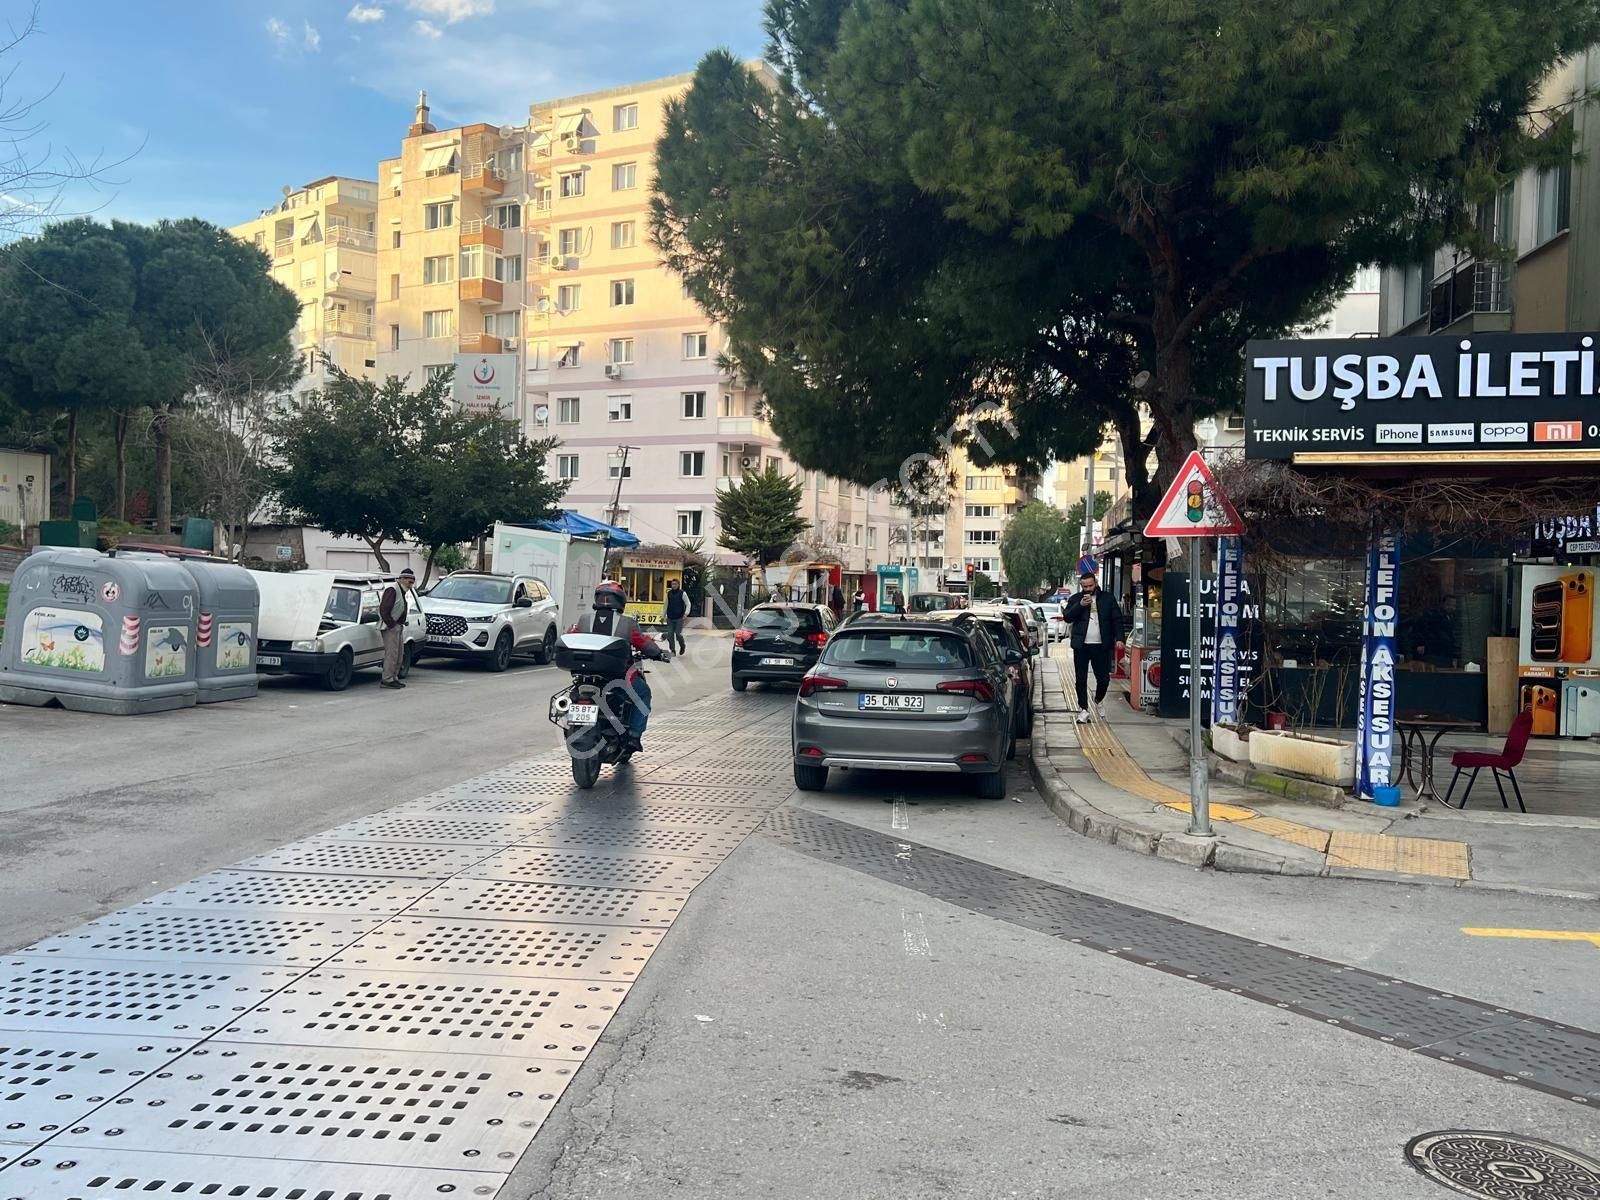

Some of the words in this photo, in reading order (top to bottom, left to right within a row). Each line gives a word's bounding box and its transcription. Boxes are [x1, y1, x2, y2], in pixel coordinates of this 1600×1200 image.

[1253, 353, 1442, 410] TUŞBA
[1458, 336, 1600, 397] İLETİ
[1253, 426, 1310, 442] TEKNİK
[1312, 425, 1365, 441] SERVİS
[1379, 428, 1419, 440] iPhone
[1429, 428, 1473, 438] SAMSUNG
[865, 695, 877, 706] 35
[881, 696, 900, 707] CNK
[904, 697, 922, 708] 923
[1368, 645, 1394, 784] AKSESUAR
